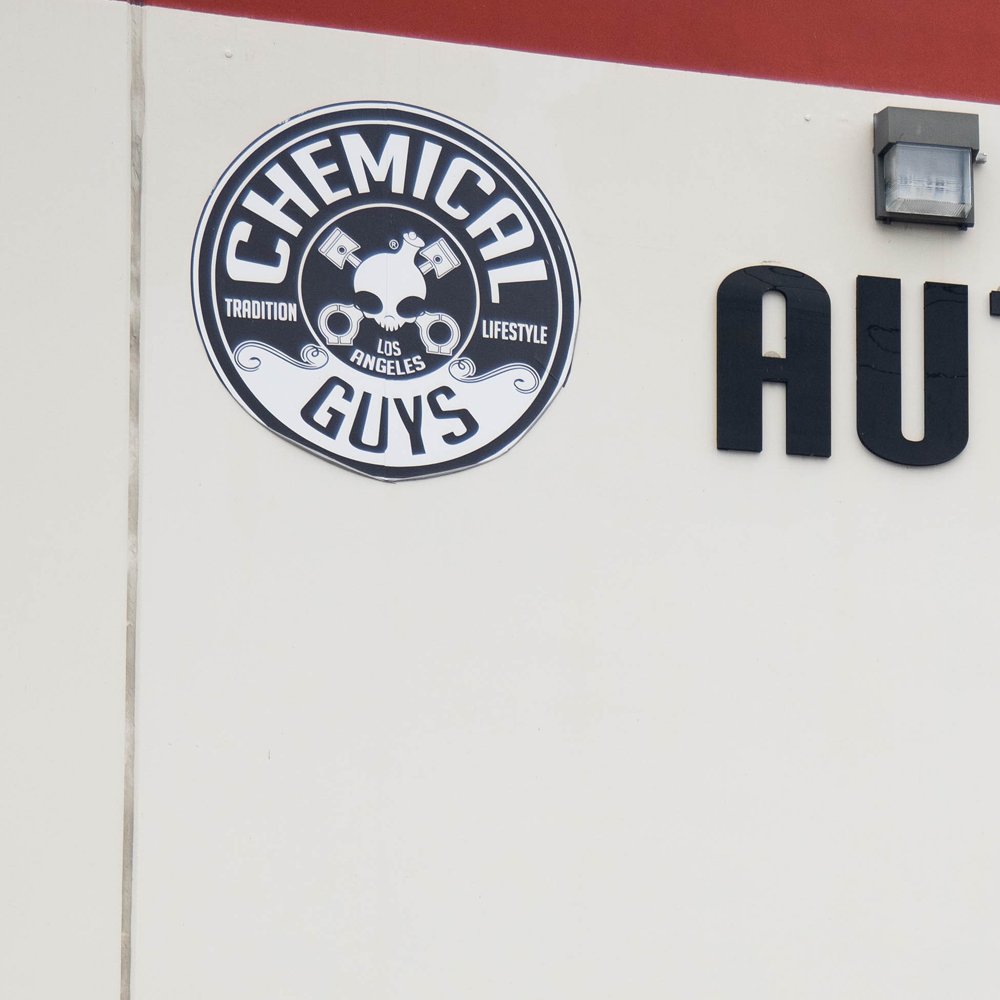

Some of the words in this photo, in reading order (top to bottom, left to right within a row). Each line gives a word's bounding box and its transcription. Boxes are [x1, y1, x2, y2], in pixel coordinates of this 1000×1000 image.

[227, 133, 548, 304] CHEMICAL
[225, 298, 297, 322] TRADITION
[482, 320, 548, 345] LIFESTYLE
[376, 338, 401, 357] LOS
[349, 348, 426, 376] ANGELES
[300, 376, 480, 456] GUYS
